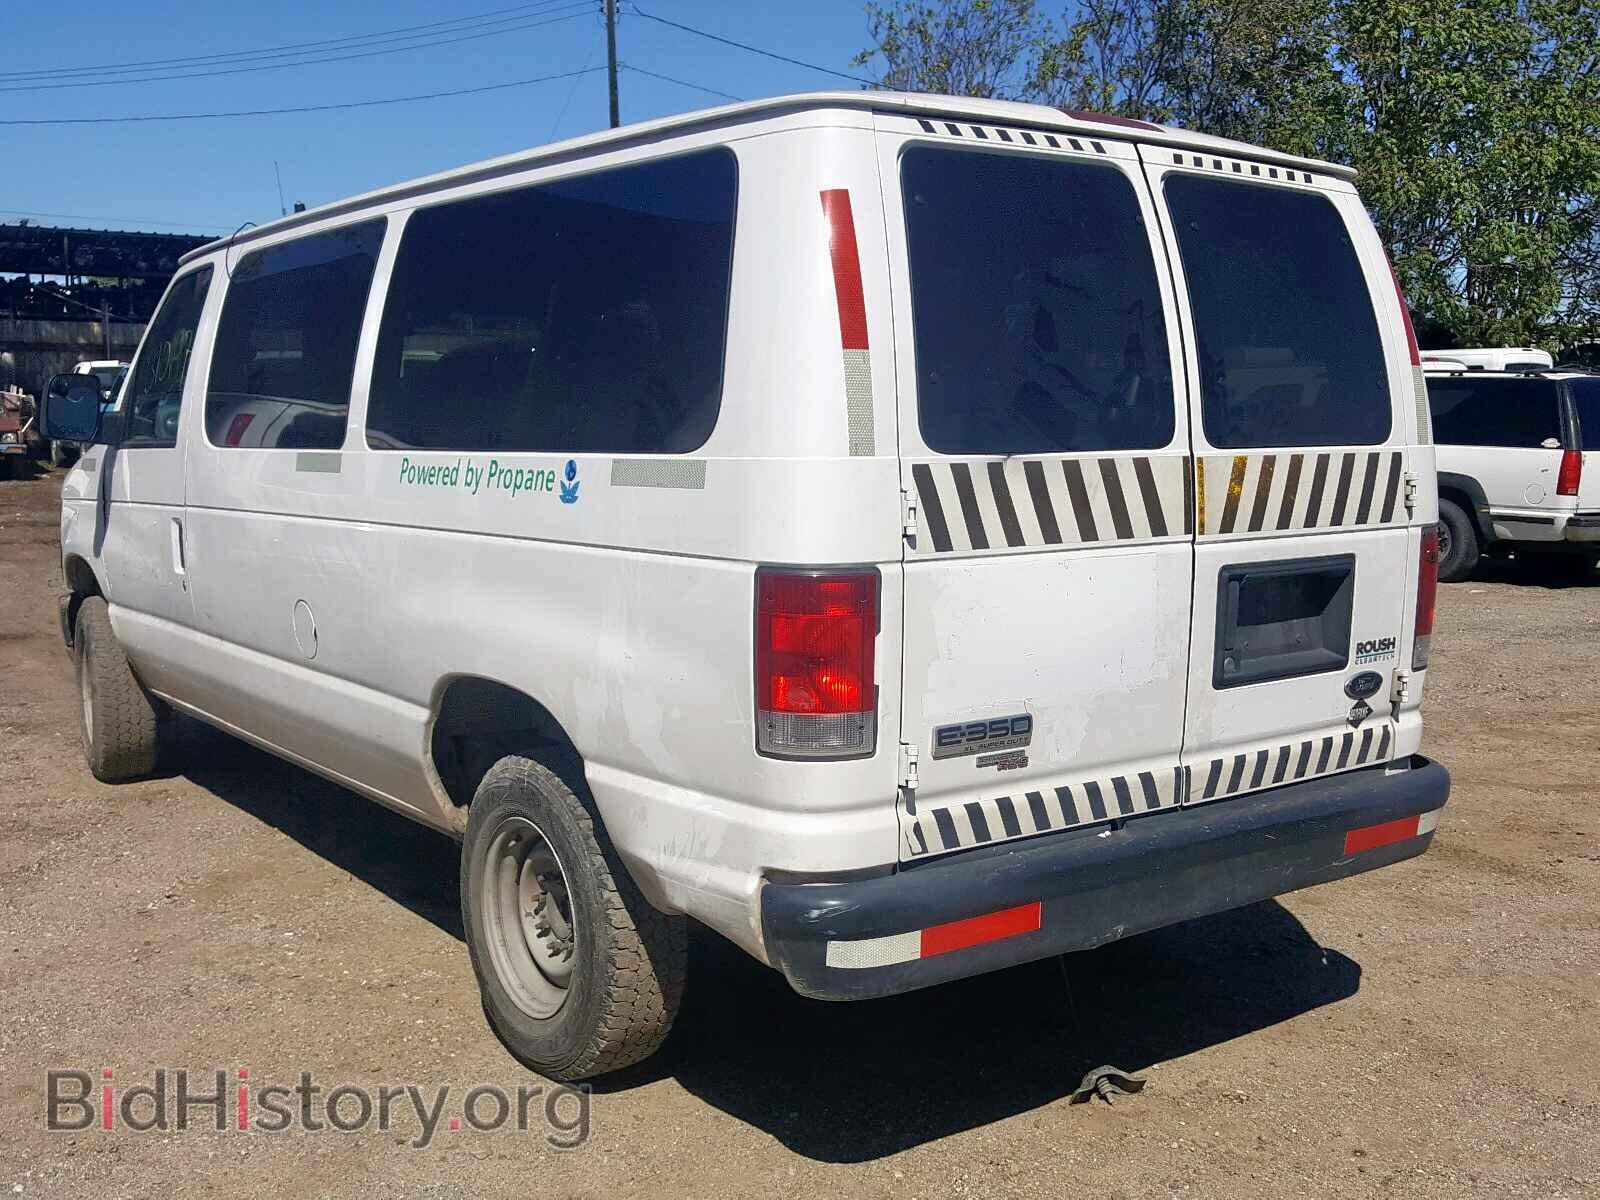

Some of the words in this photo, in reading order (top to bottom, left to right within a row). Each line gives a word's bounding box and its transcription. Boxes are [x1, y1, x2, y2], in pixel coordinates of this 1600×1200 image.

[399, 457, 461, 488] Powered
[464, 456, 484, 496] by
[487, 459, 556, 498] Propane
[1356, 637, 1397, 655] ROUSH
[1355, 653, 1395, 665] CLEANTECH
[978, 740, 1006, 750] SUPER
[1007, 736, 1029, 746] DUTY
